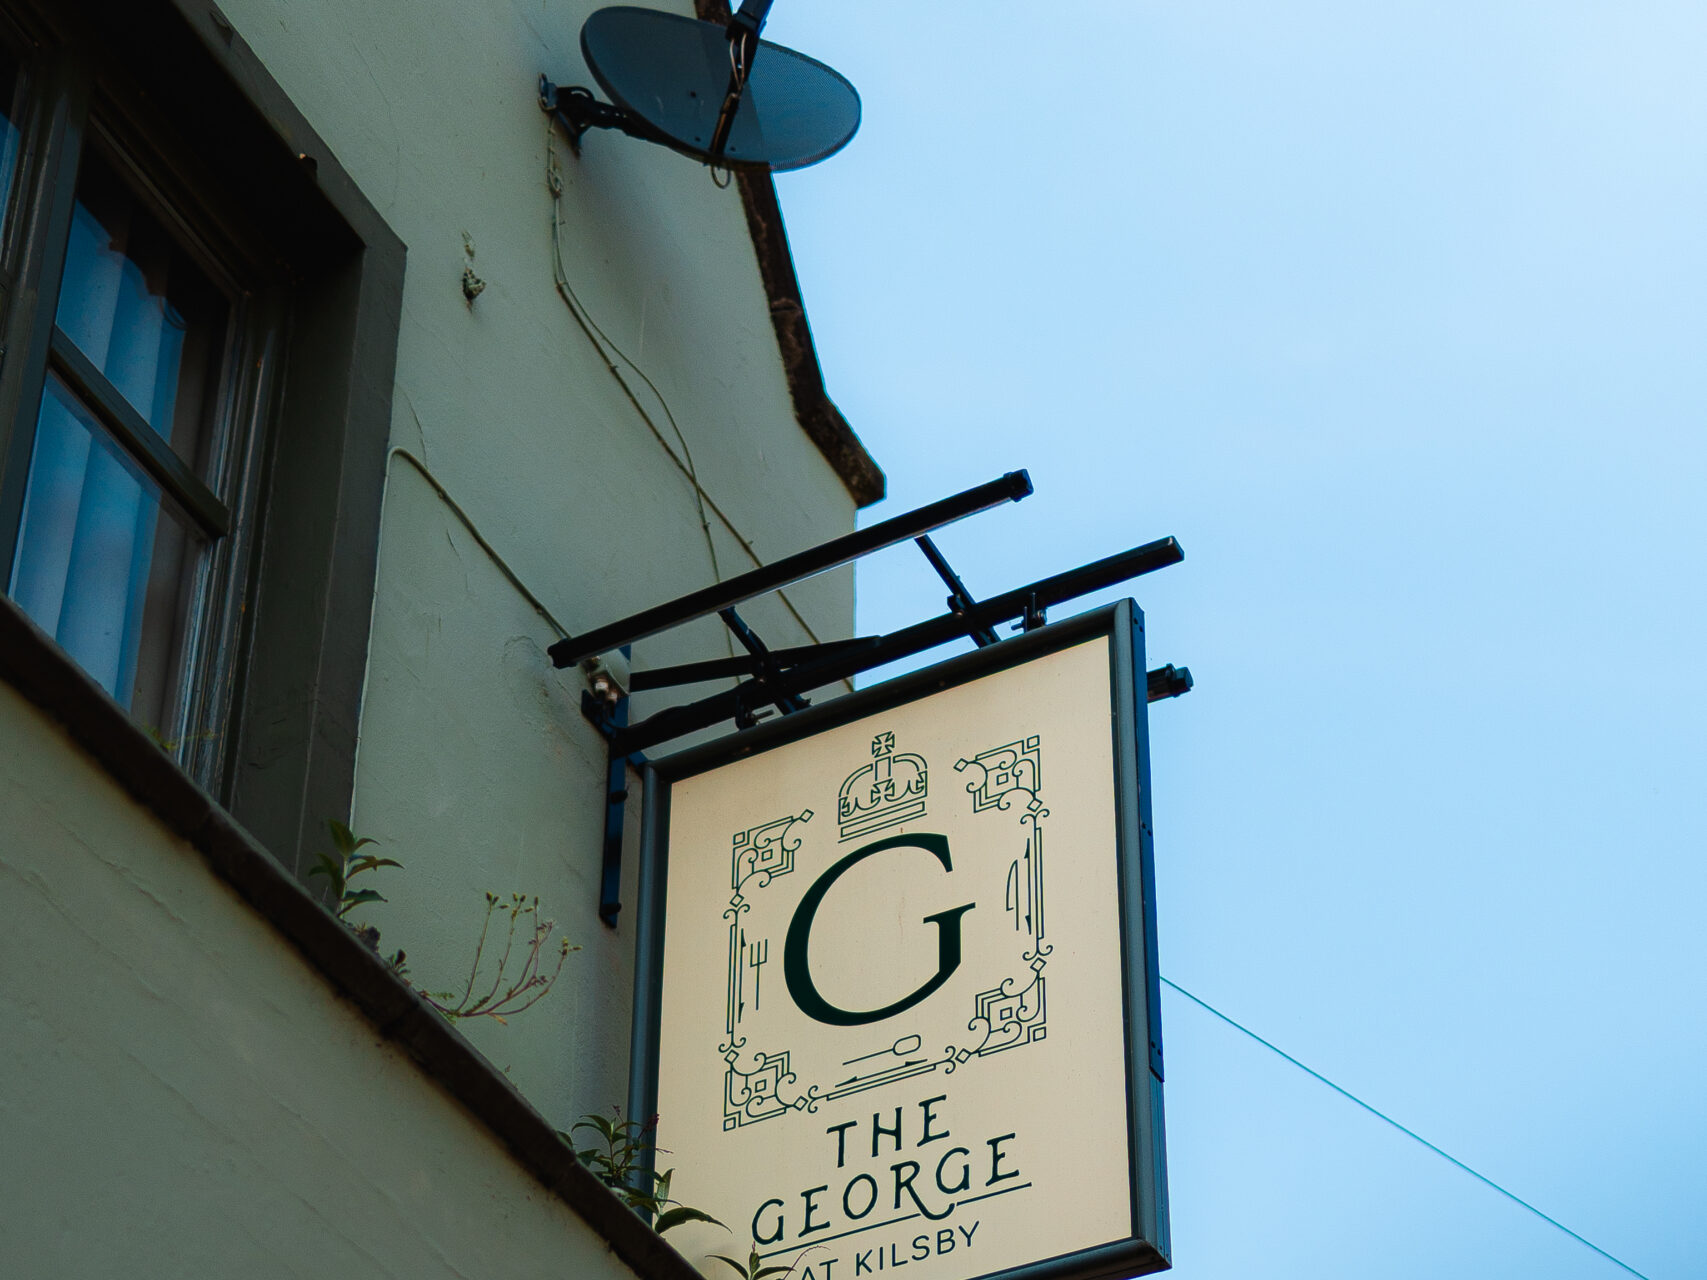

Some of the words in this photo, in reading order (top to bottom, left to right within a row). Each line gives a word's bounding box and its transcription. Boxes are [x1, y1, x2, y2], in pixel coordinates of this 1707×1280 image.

[783, 832, 976, 1027] G
[826, 1094, 951, 1169] THE
[751, 1132, 1020, 1246] GEORGE
[855, 1220, 980, 1277] KILSBY
